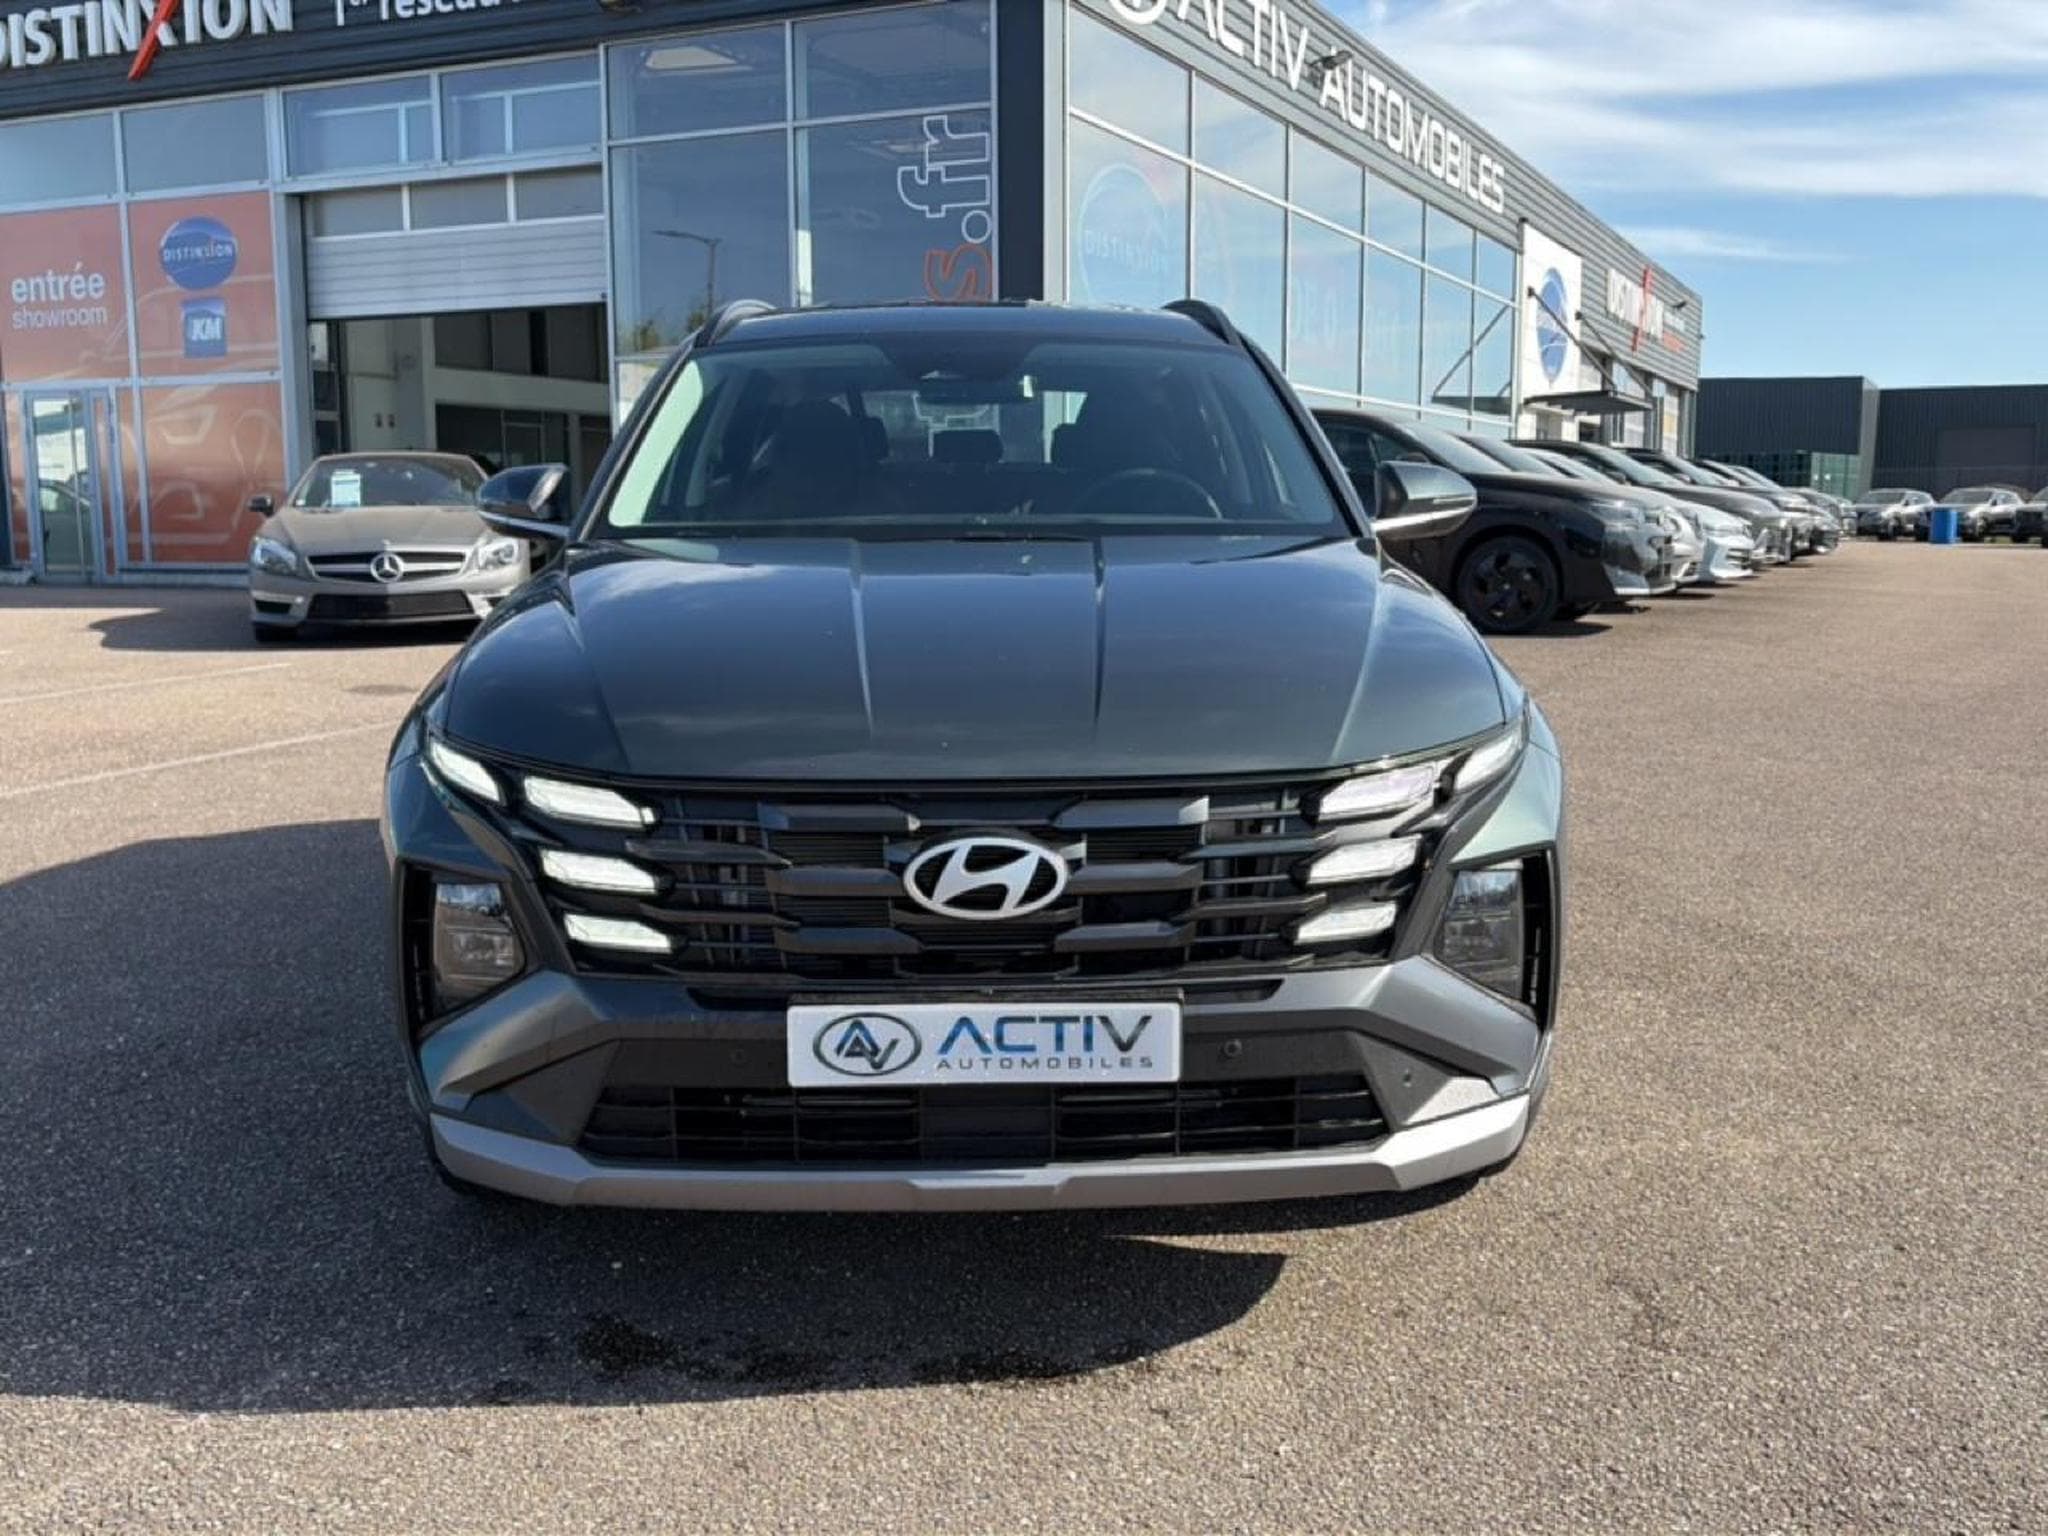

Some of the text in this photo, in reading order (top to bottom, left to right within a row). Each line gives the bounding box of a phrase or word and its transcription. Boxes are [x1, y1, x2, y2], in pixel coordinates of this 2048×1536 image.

[1319, 47, 1506, 213] AUTOMOBILES
[11, 261, 105, 303] entrée
[12, 305, 107, 330] showroom
[937, 1015, 1152, 1055] ACTIV
[936, 1057, 1153, 1070] AUTOMOBILES
